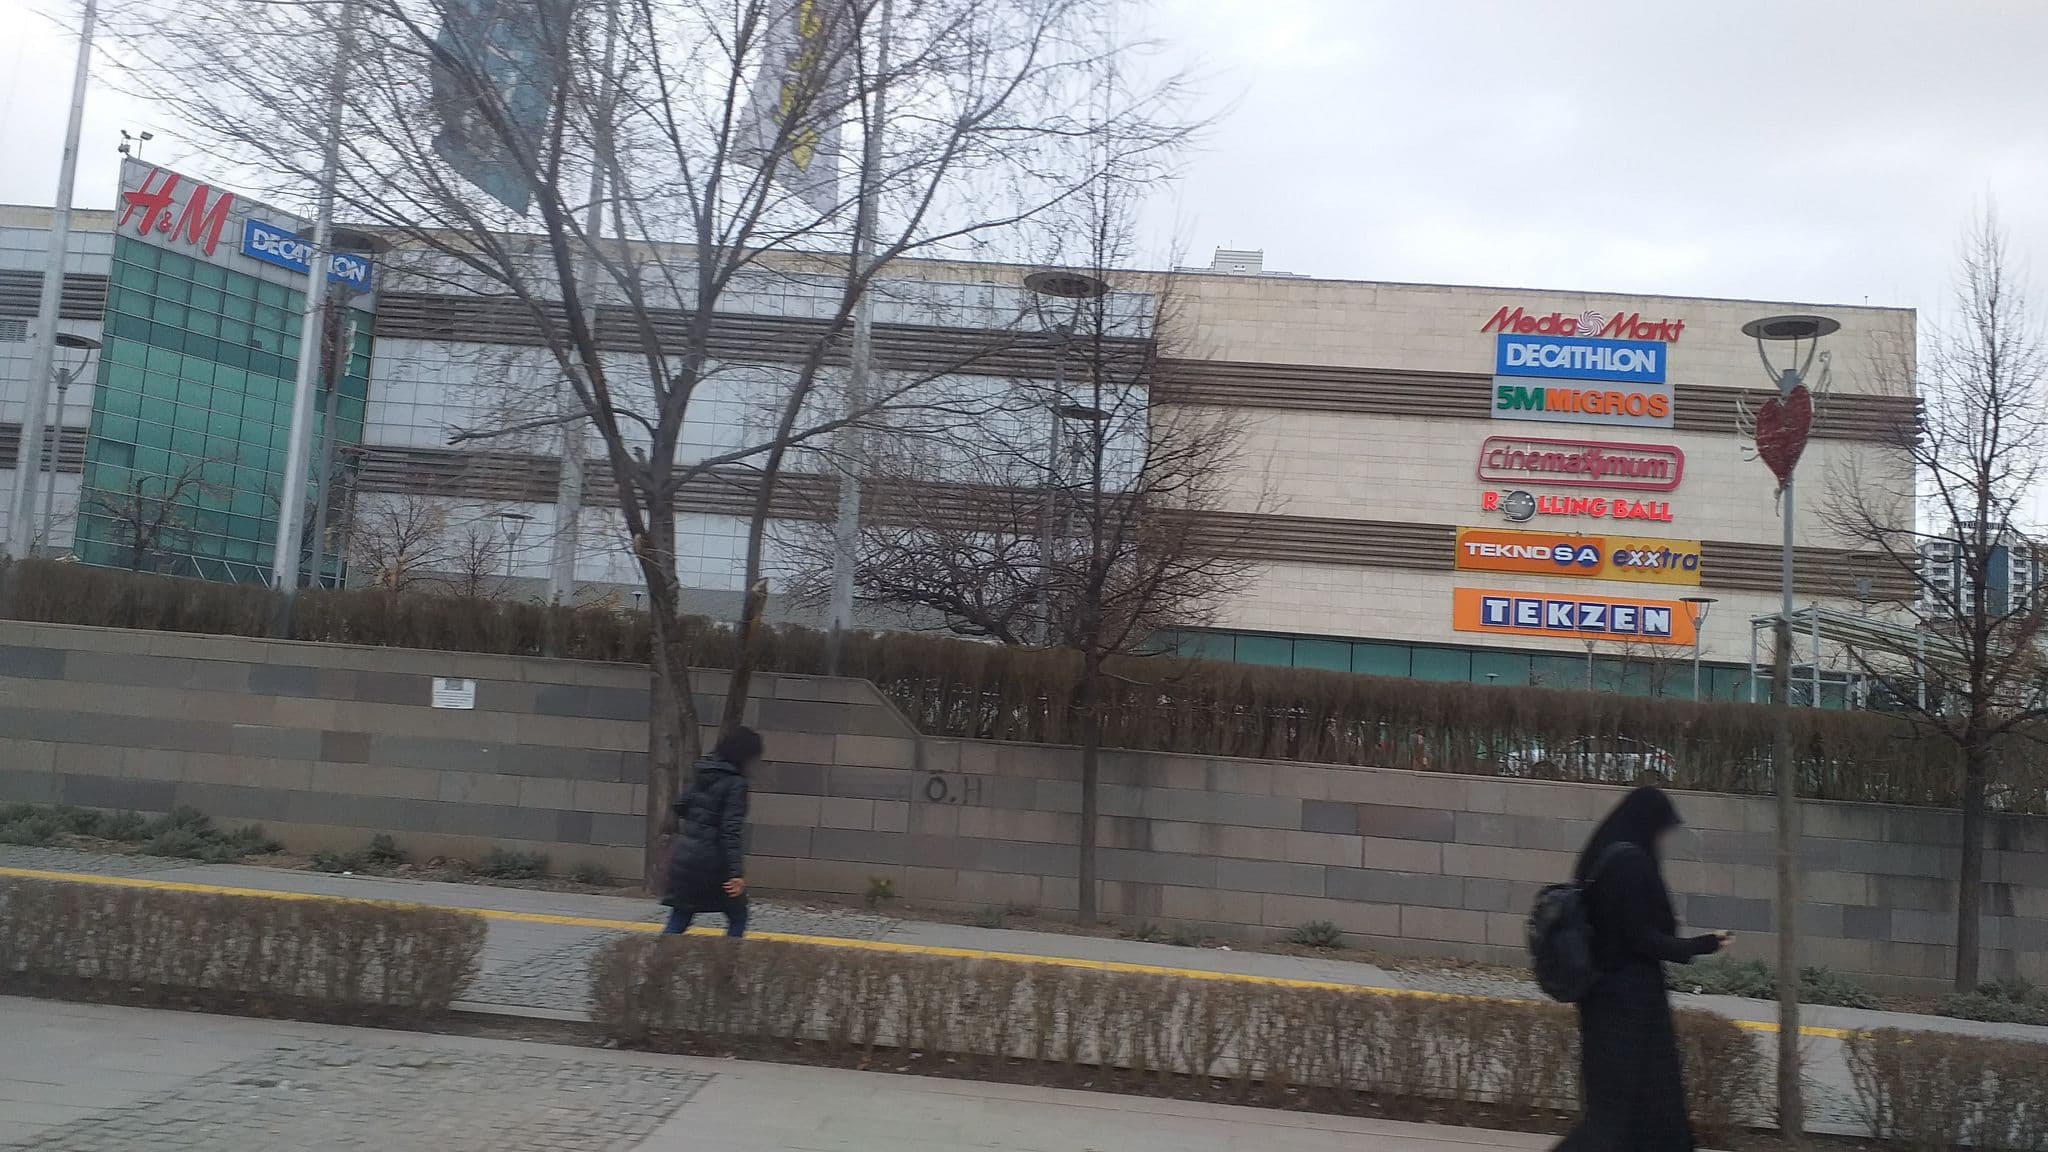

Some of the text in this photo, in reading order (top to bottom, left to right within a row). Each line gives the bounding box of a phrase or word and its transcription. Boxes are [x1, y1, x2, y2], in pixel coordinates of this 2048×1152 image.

[120, 167, 235, 257] H&M
[252, 228, 366, 282] DECATLON
[1481, 306, 1686, 343] Media Markt
[1506, 343, 1656, 373] DECATHLON
[1612, 499, 1673, 523] BALL
[1612, 547, 1699, 572] exxtra
[1484, 597, 1670, 634] TEKZEN
